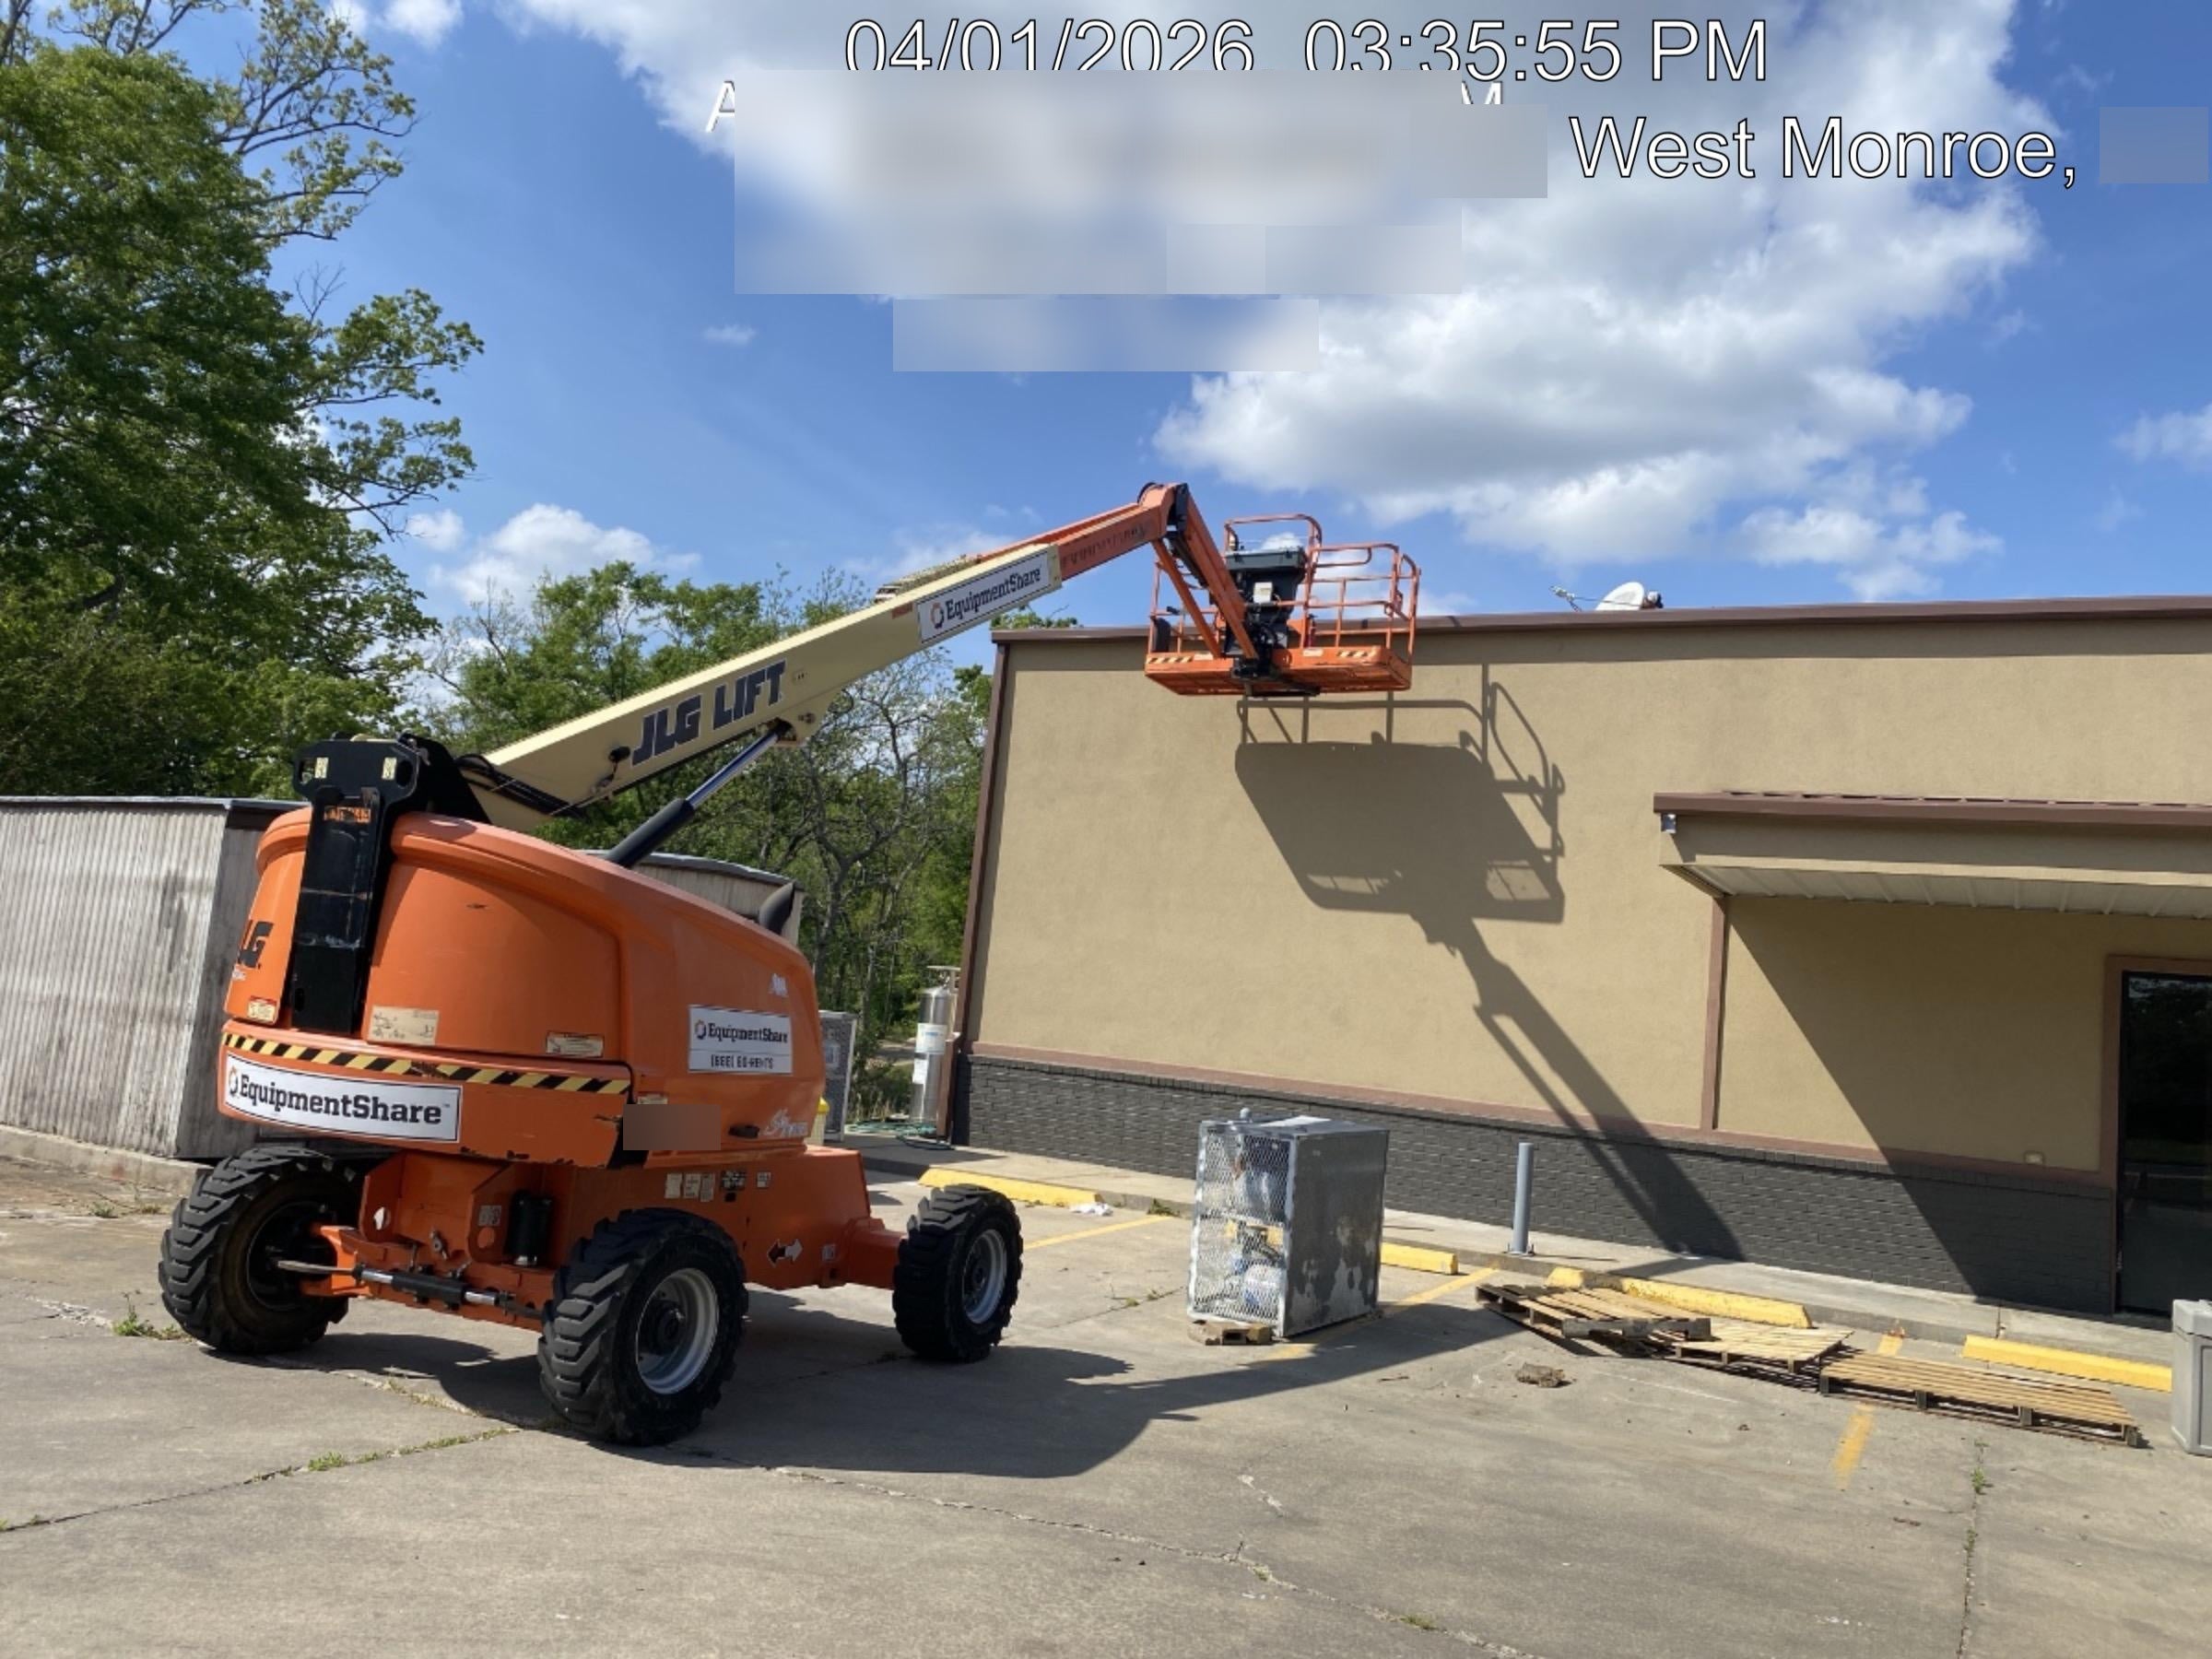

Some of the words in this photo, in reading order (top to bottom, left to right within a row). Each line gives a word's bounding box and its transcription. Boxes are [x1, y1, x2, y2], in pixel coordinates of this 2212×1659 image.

[945, 566, 1041, 620] EquipmentShare
[631, 694, 701, 758] JLG
[712, 659, 786, 731] LIFT
[708, 1022, 789, 1043] EquipmentShare
[240, 1073, 442, 1125] EquipmentShare
